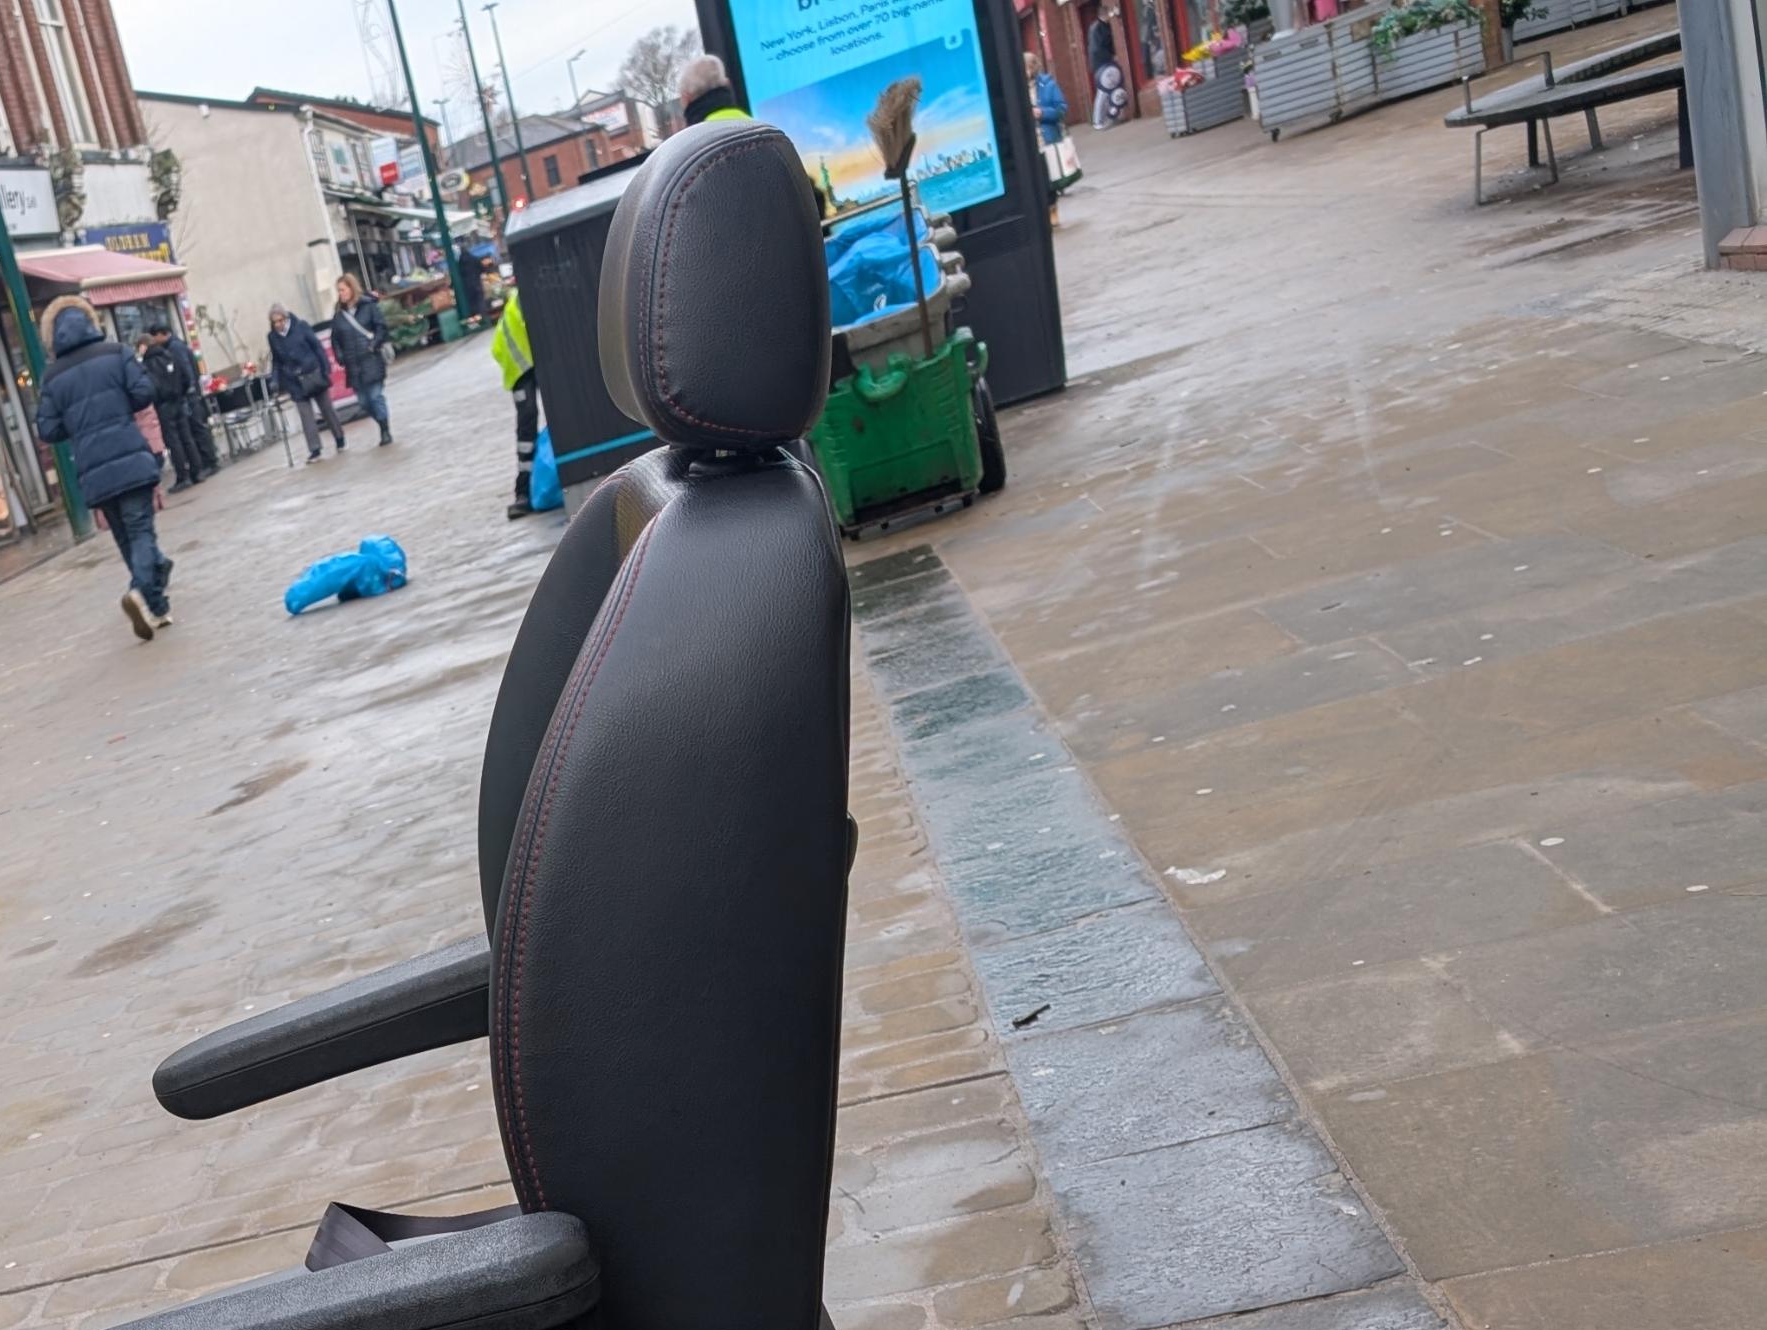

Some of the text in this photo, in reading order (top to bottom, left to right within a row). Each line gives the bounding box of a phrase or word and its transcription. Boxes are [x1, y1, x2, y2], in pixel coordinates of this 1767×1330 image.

[760, 37, 785, 51] New
[775, 41, 815, 60] choose
[817, 30, 845, 45] from
[847, 20, 872, 34] over
[874, 12, 890, 24] 70
